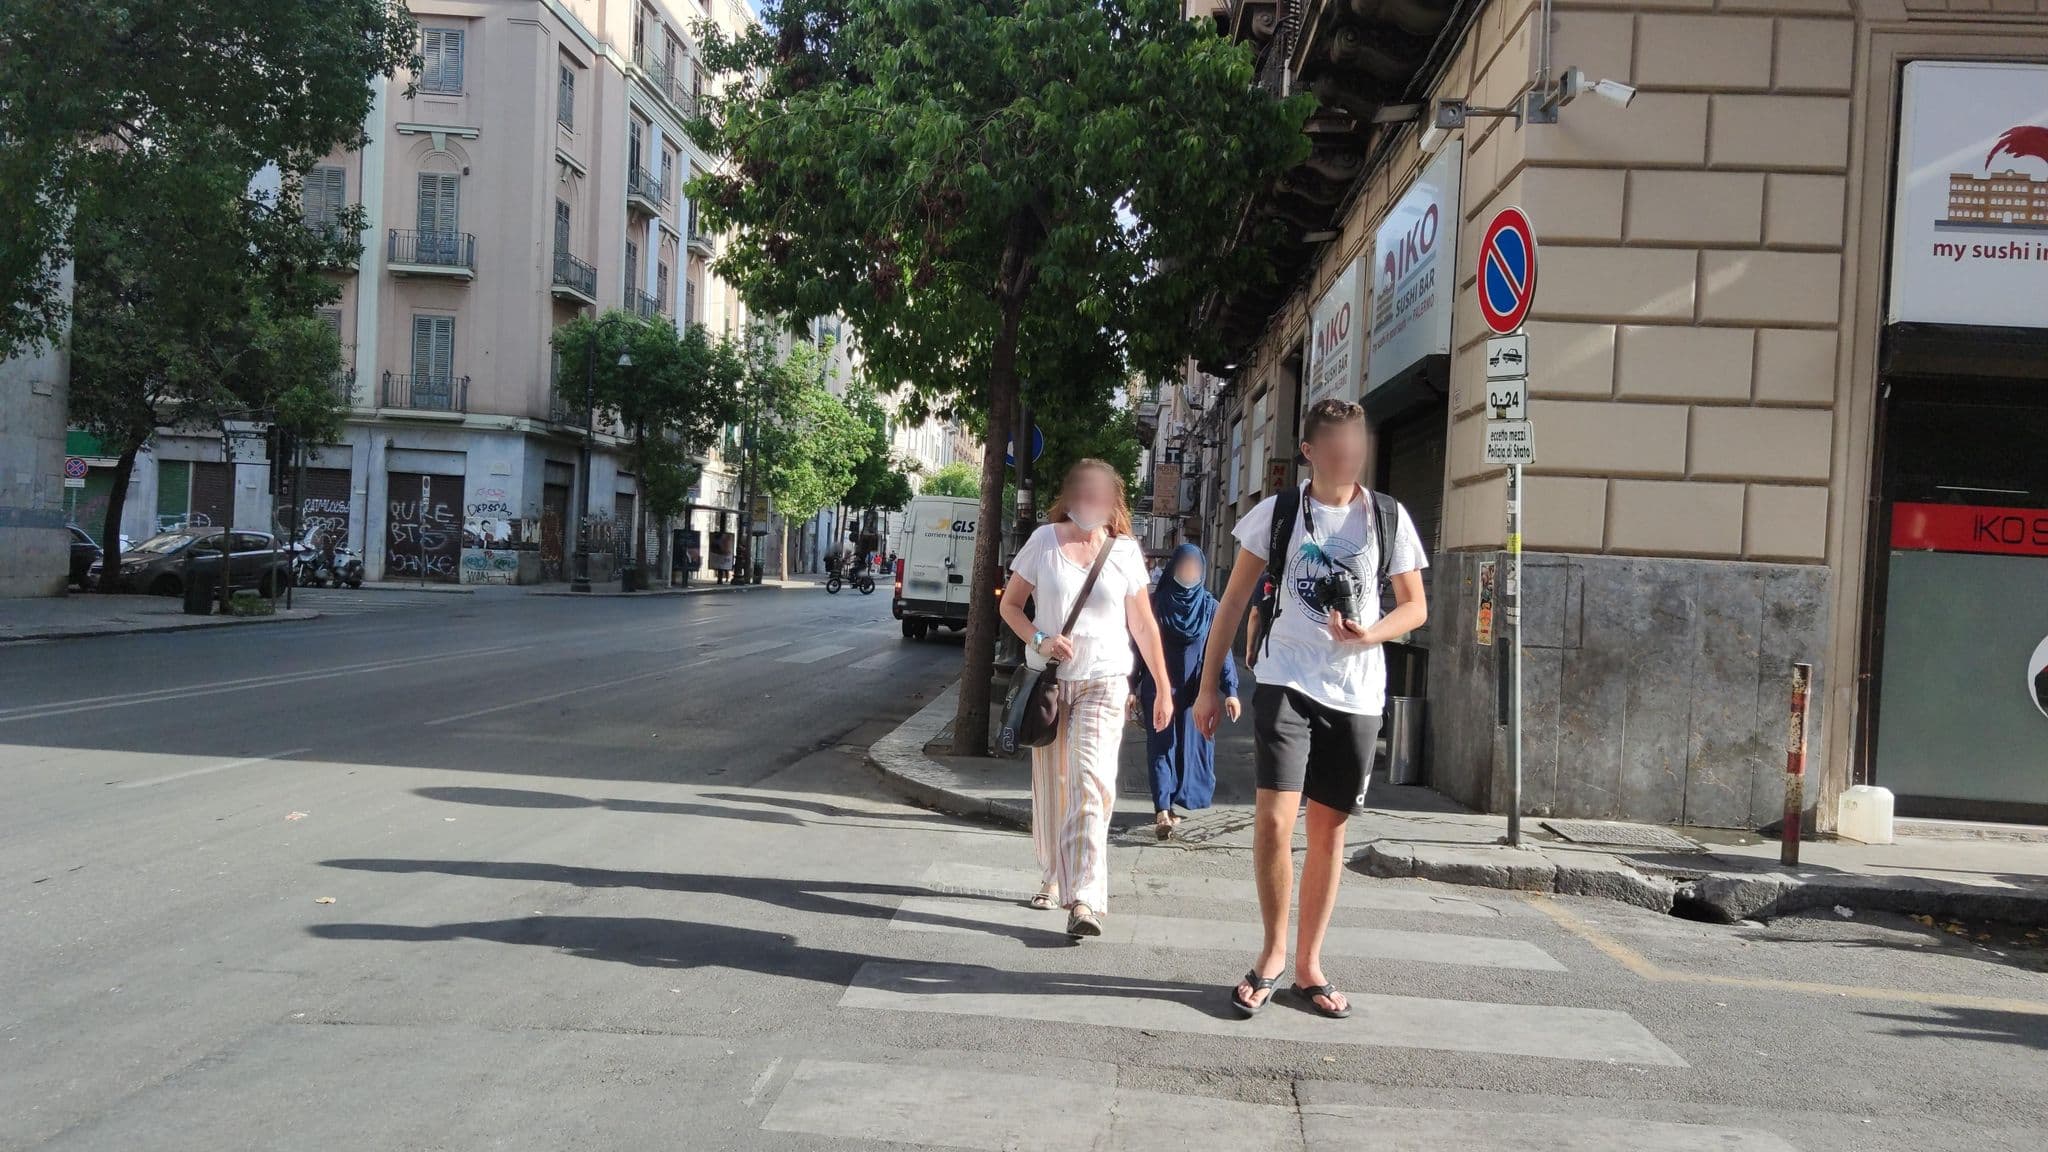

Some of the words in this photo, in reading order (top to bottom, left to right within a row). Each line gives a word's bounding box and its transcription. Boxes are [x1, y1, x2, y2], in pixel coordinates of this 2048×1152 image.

[1933, 242, 1967, 262] my
[1972, 241, 2031, 260] sushi
[1395, 282, 1418, 318] SUSHI
[1418, 267, 1435, 298] BAR
[1338, 353, 1348, 374] BAR
[1490, 429, 1508, 442] eccetto
[1509, 427, 1526, 442] mezzi
[1488, 444, 1506, 459] Polizia
[1507, 445, 1513, 458] di
[1514, 441, 1531, 458] Stato
[924, 531, 947, 539] corriere
[948, 533, 975, 541] espresso
[952, 520, 976, 533] GLS
[1973, 514, 2026, 545] IKO
